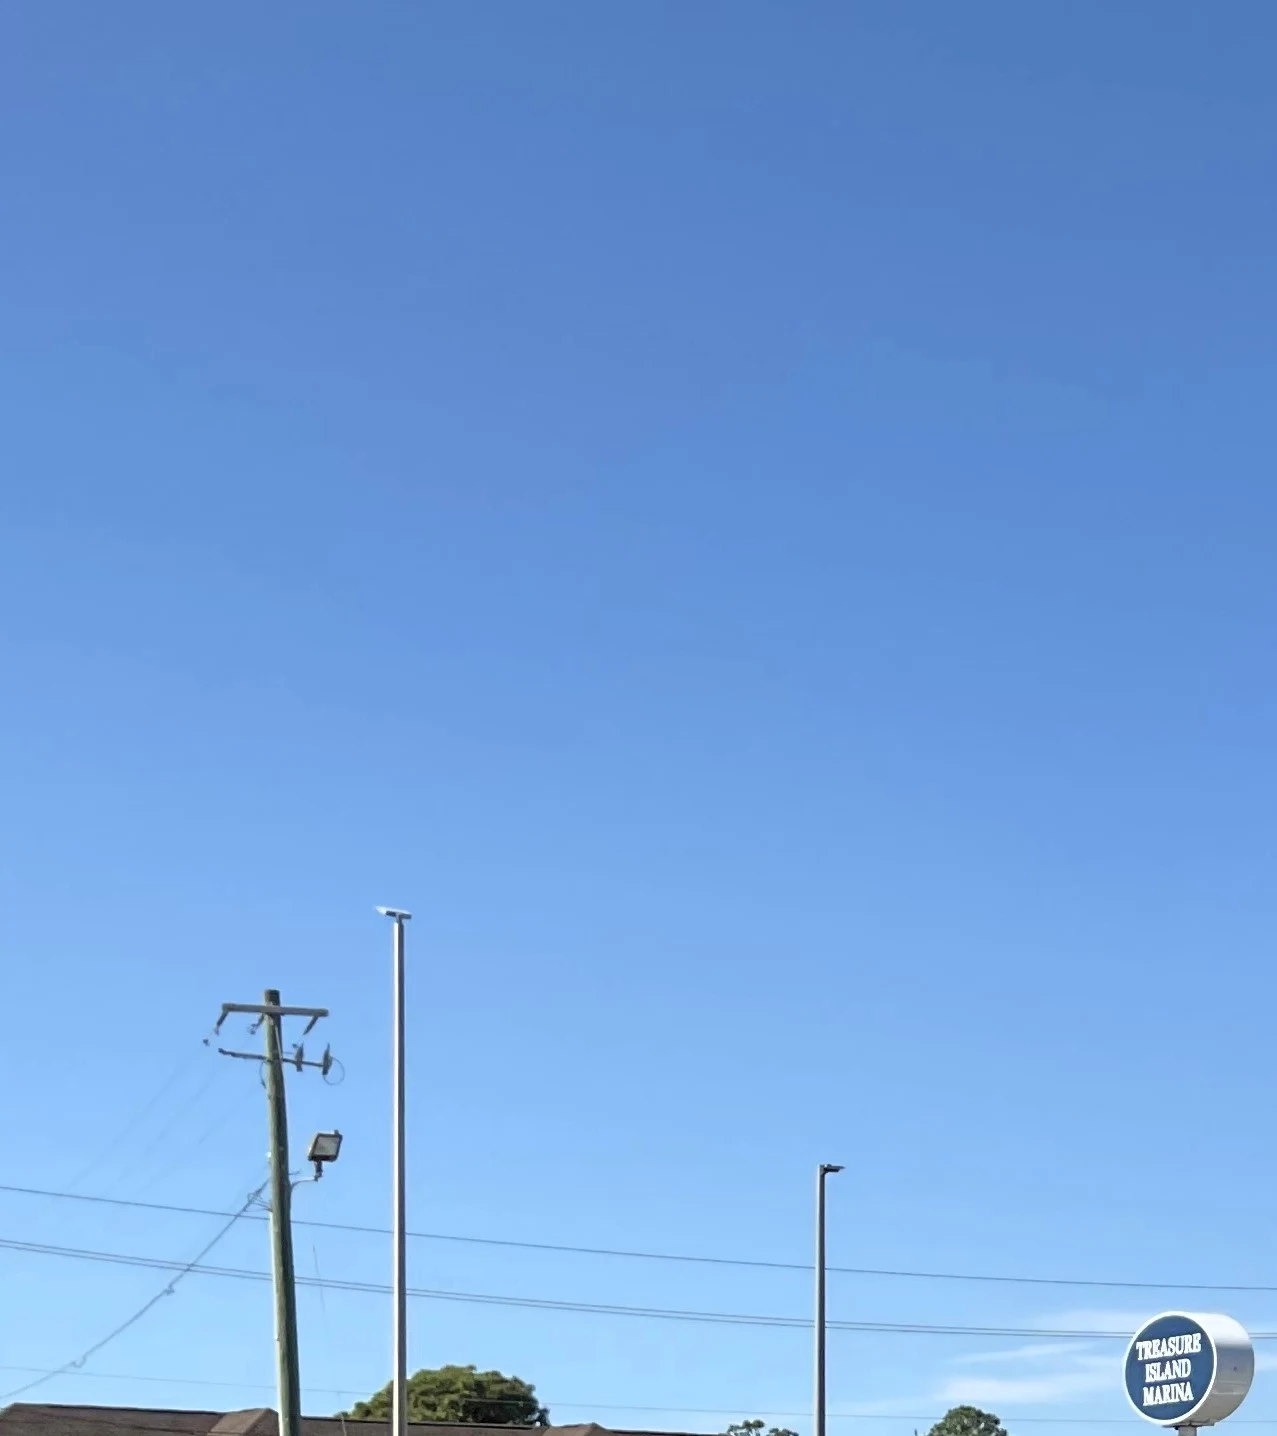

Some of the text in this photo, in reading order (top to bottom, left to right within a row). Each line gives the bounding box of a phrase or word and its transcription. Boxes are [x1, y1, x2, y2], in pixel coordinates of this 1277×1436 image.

[1136, 1333, 1201, 1361] TREASURE
[1145, 1358, 1191, 1383] ISLAND
[1143, 1382, 1194, 1406] MARINA
